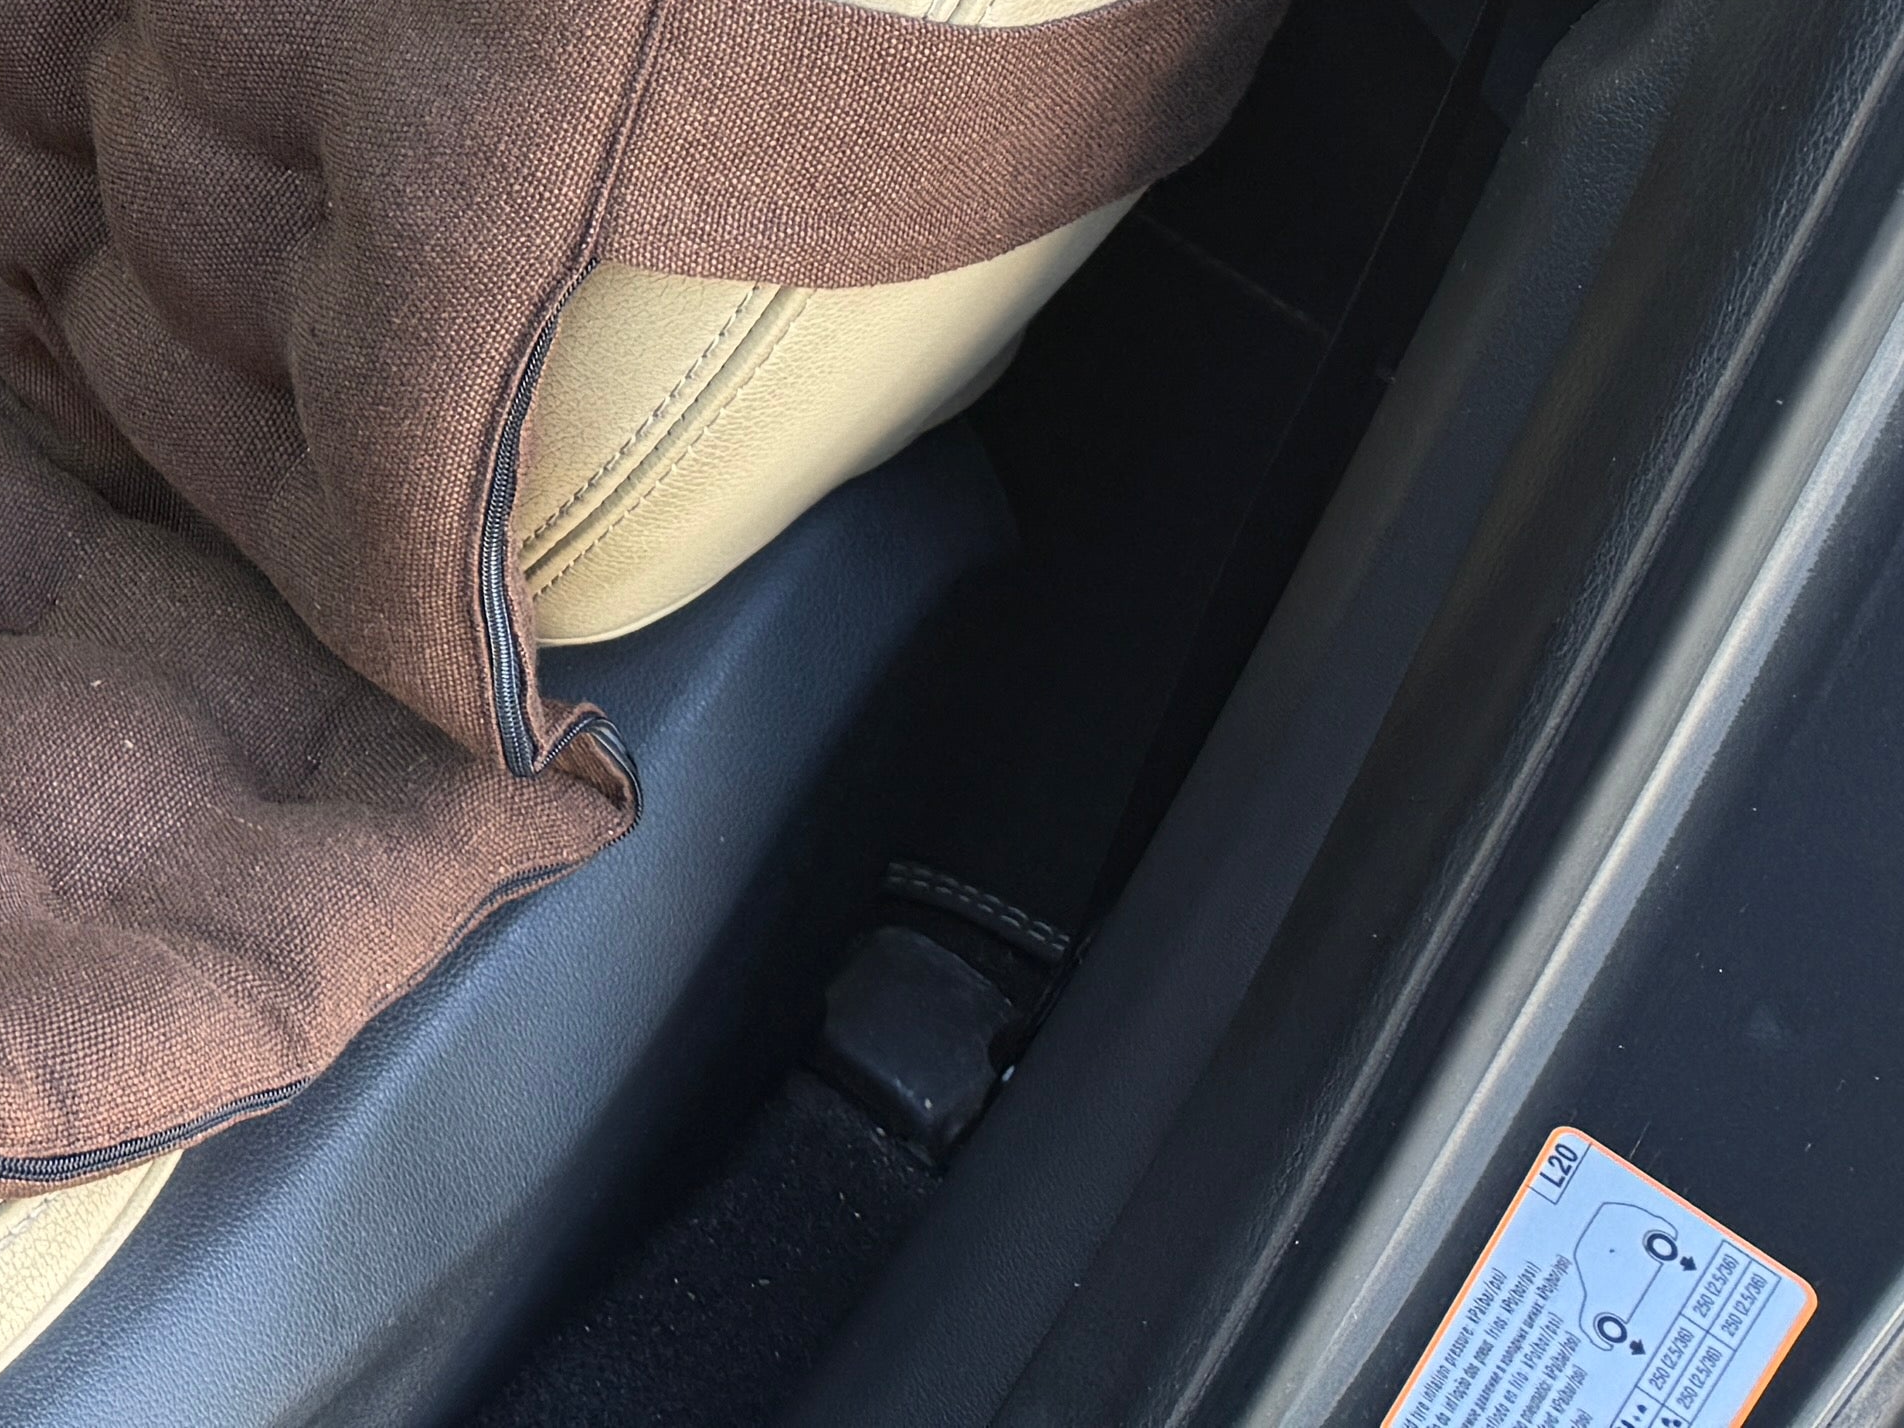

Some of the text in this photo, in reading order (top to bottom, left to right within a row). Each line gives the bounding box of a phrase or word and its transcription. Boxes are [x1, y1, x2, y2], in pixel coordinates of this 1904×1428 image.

[1538, 1142, 1580, 1189] L20
[1692, 1252, 1740, 1318] 250 (2.5/36)
[1720, 1272, 1768, 1338] 250 (2.5/36)
[1648, 1326, 1695, 1392] 250 (2.5/36)
[1676, 1345, 1724, 1411] 250 (2.5/36)
